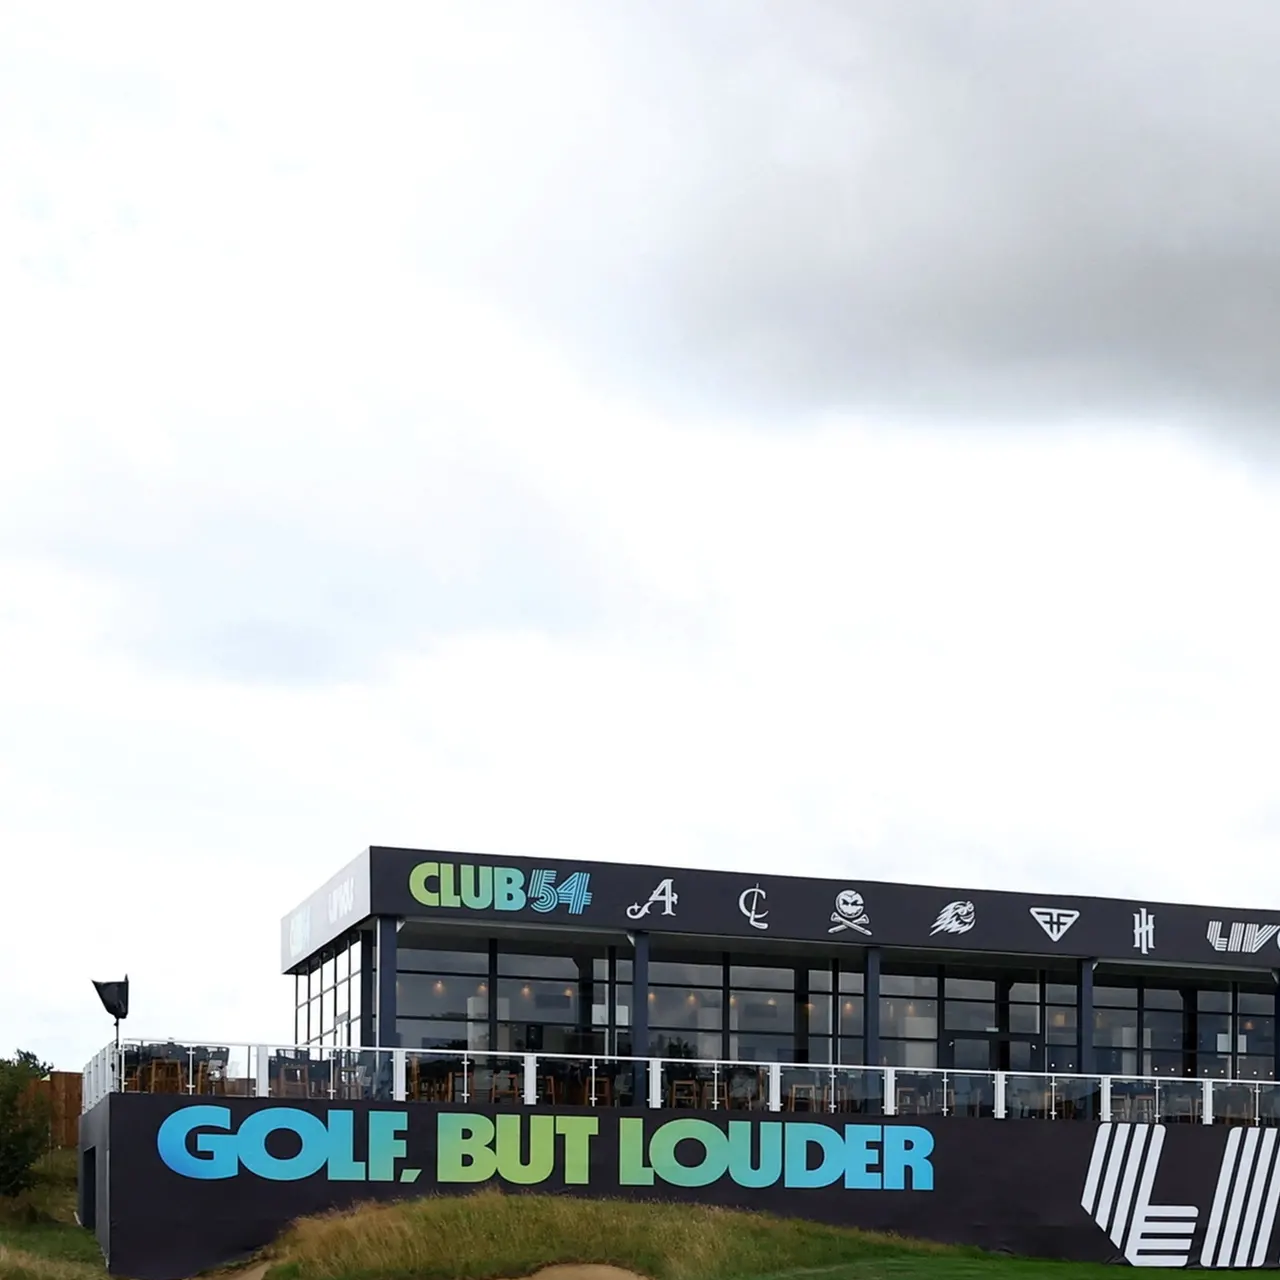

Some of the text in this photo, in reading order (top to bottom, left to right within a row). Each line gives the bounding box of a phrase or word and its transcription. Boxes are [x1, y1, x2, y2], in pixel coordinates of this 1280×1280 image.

[409, 861, 527, 912] CLUB
[527, 868, 593, 915] 54
[157, 1104, 936, 1192] GOLF, BUT LOUDER
